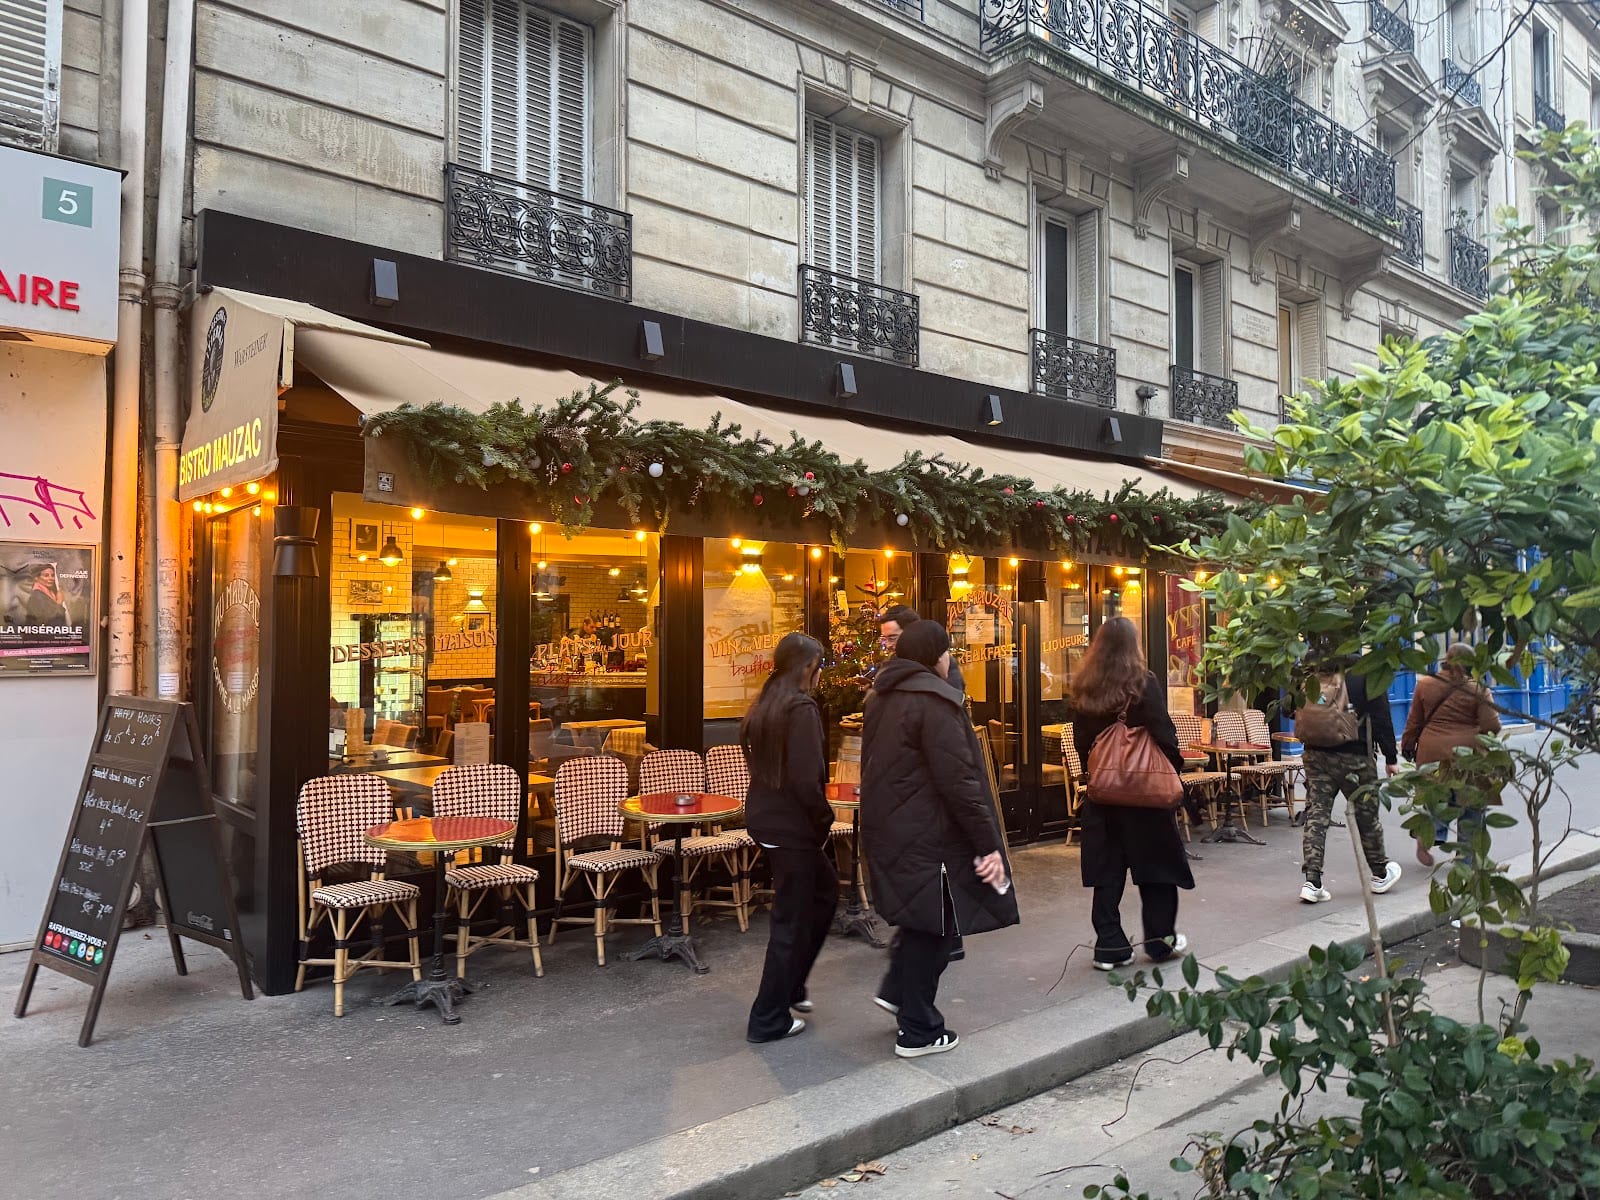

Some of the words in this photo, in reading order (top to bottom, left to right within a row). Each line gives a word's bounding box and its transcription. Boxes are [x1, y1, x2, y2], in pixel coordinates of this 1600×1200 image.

[58, 189, 78, 215] 5
[180, 442, 212, 486] BISTRO
[213, 417, 262, 474] MAUZAC
[226, 579, 260, 627] MAUZAC
[0, 625, 15, 634] LA
[17, 624, 83, 635] MISÉRABLE
[332, 636, 427, 664] DESSERTS
[432, 630, 497, 653] MAISON
[532, 634, 597, 661] PLATS
[608, 630, 653, 650] JOUR
[710, 639, 738, 658] VIN
[951, 642, 1016, 664] REAKFAST
[1043, 634, 1087, 652] LIQUEURS
[113, 707, 135, 721] HAPPY
[137, 711, 161, 726] HOURS
